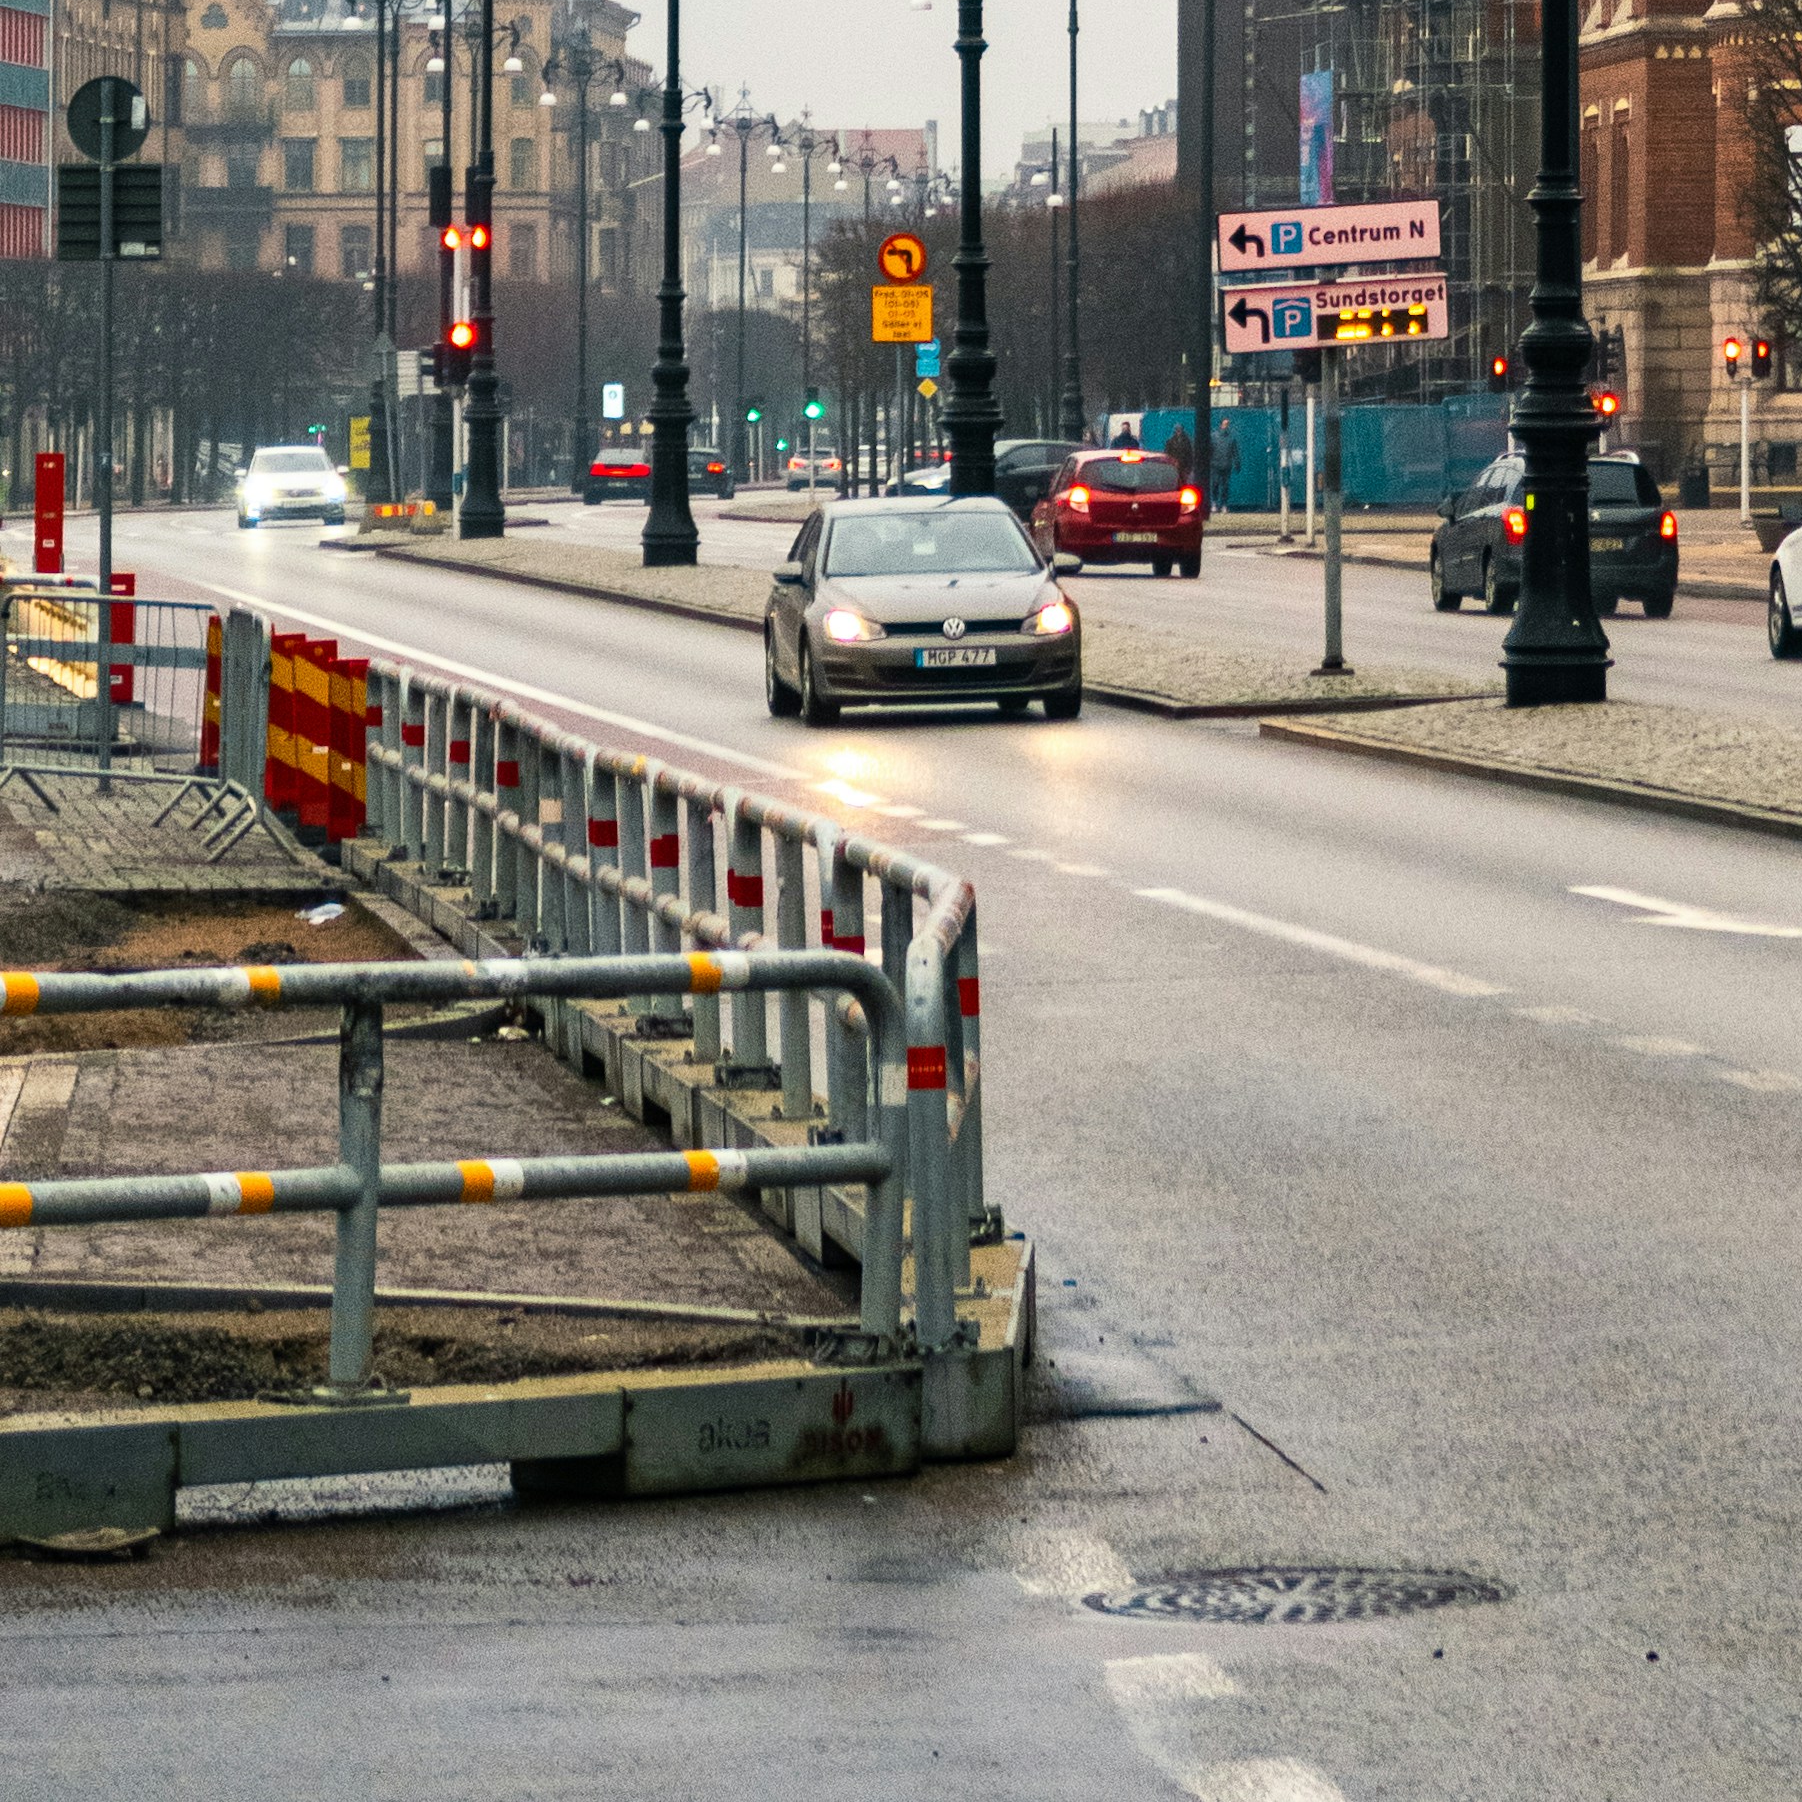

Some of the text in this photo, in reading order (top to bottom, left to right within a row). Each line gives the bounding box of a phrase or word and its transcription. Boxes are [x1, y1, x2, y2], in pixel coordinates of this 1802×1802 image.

[1309, 225, 1401, 246] Centrum
[1410, 220, 1425, 238] N
[1315, 284, 1444, 309] Sundstorget
[961, 648, 990, 664] 477
